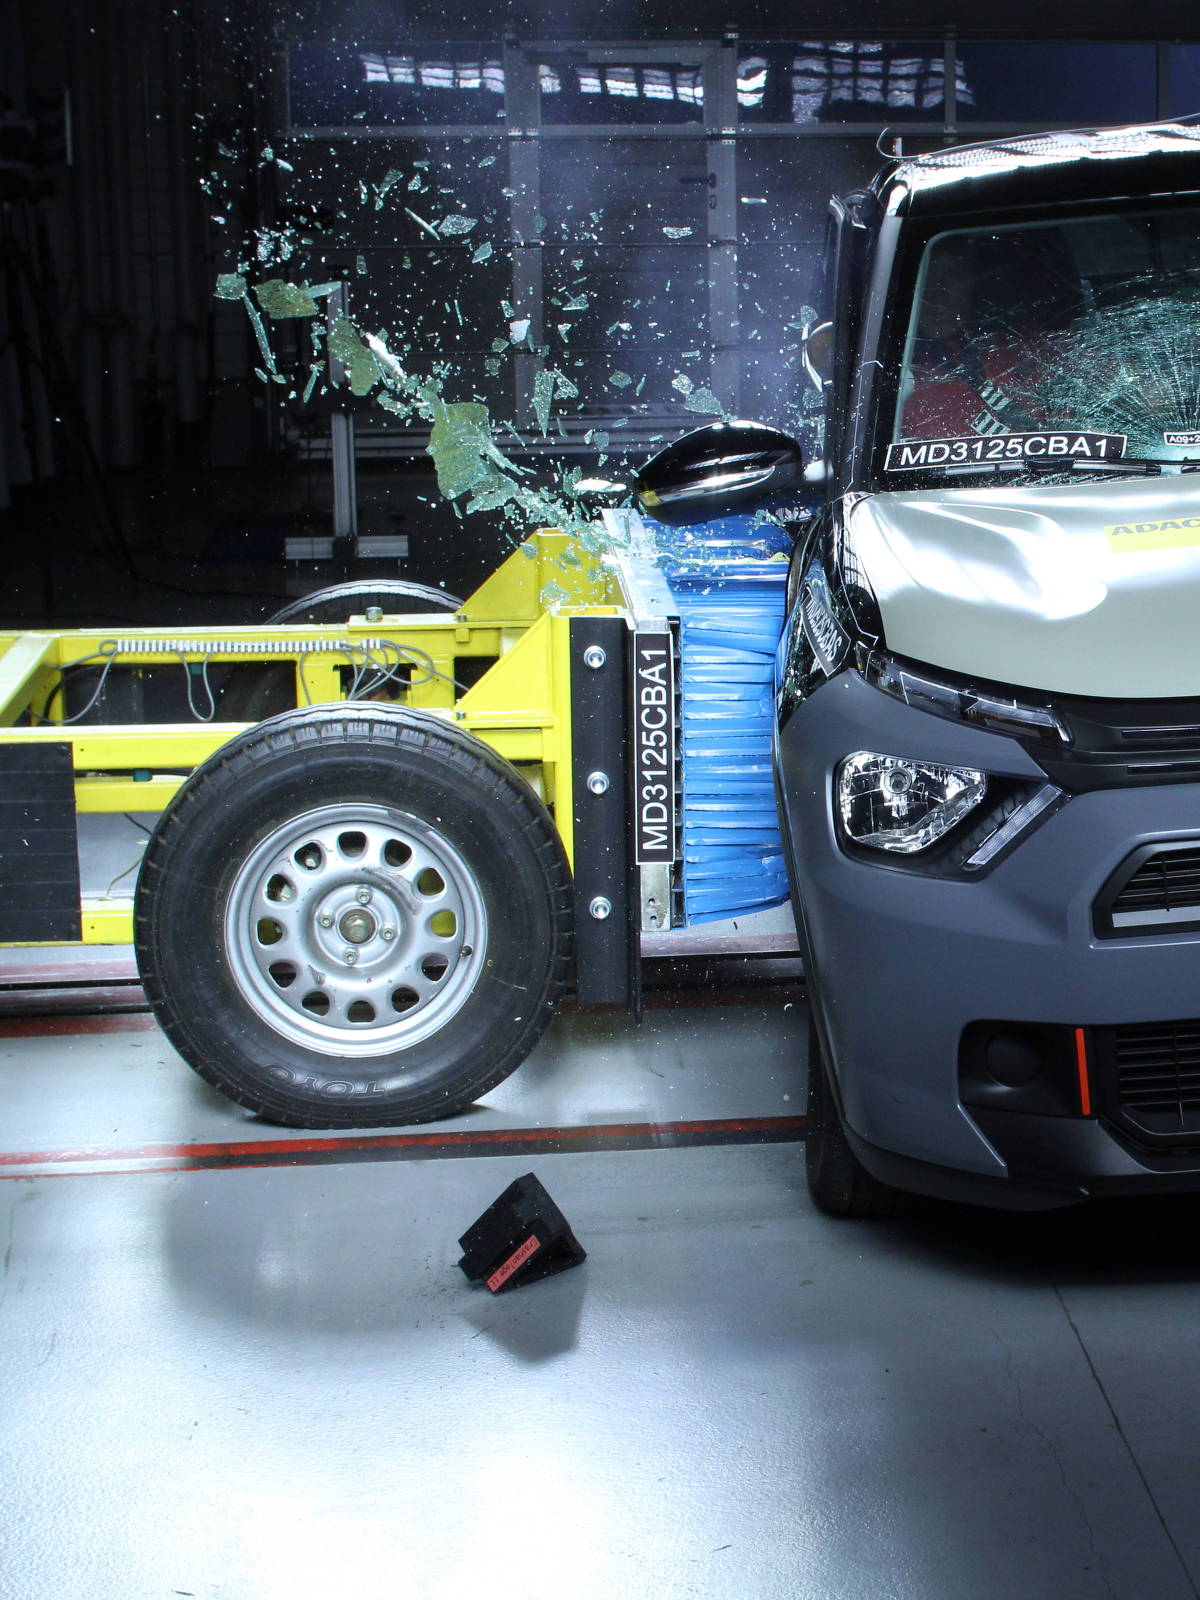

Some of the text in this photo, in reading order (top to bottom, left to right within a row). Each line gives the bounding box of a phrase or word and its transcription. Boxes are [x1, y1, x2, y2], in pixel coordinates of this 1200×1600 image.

[900, 436, 1108, 466] MD3125CBA1
[639, 649, 668, 851] MD3125CBA1
[260, 1064, 387, 1097] TOYO
